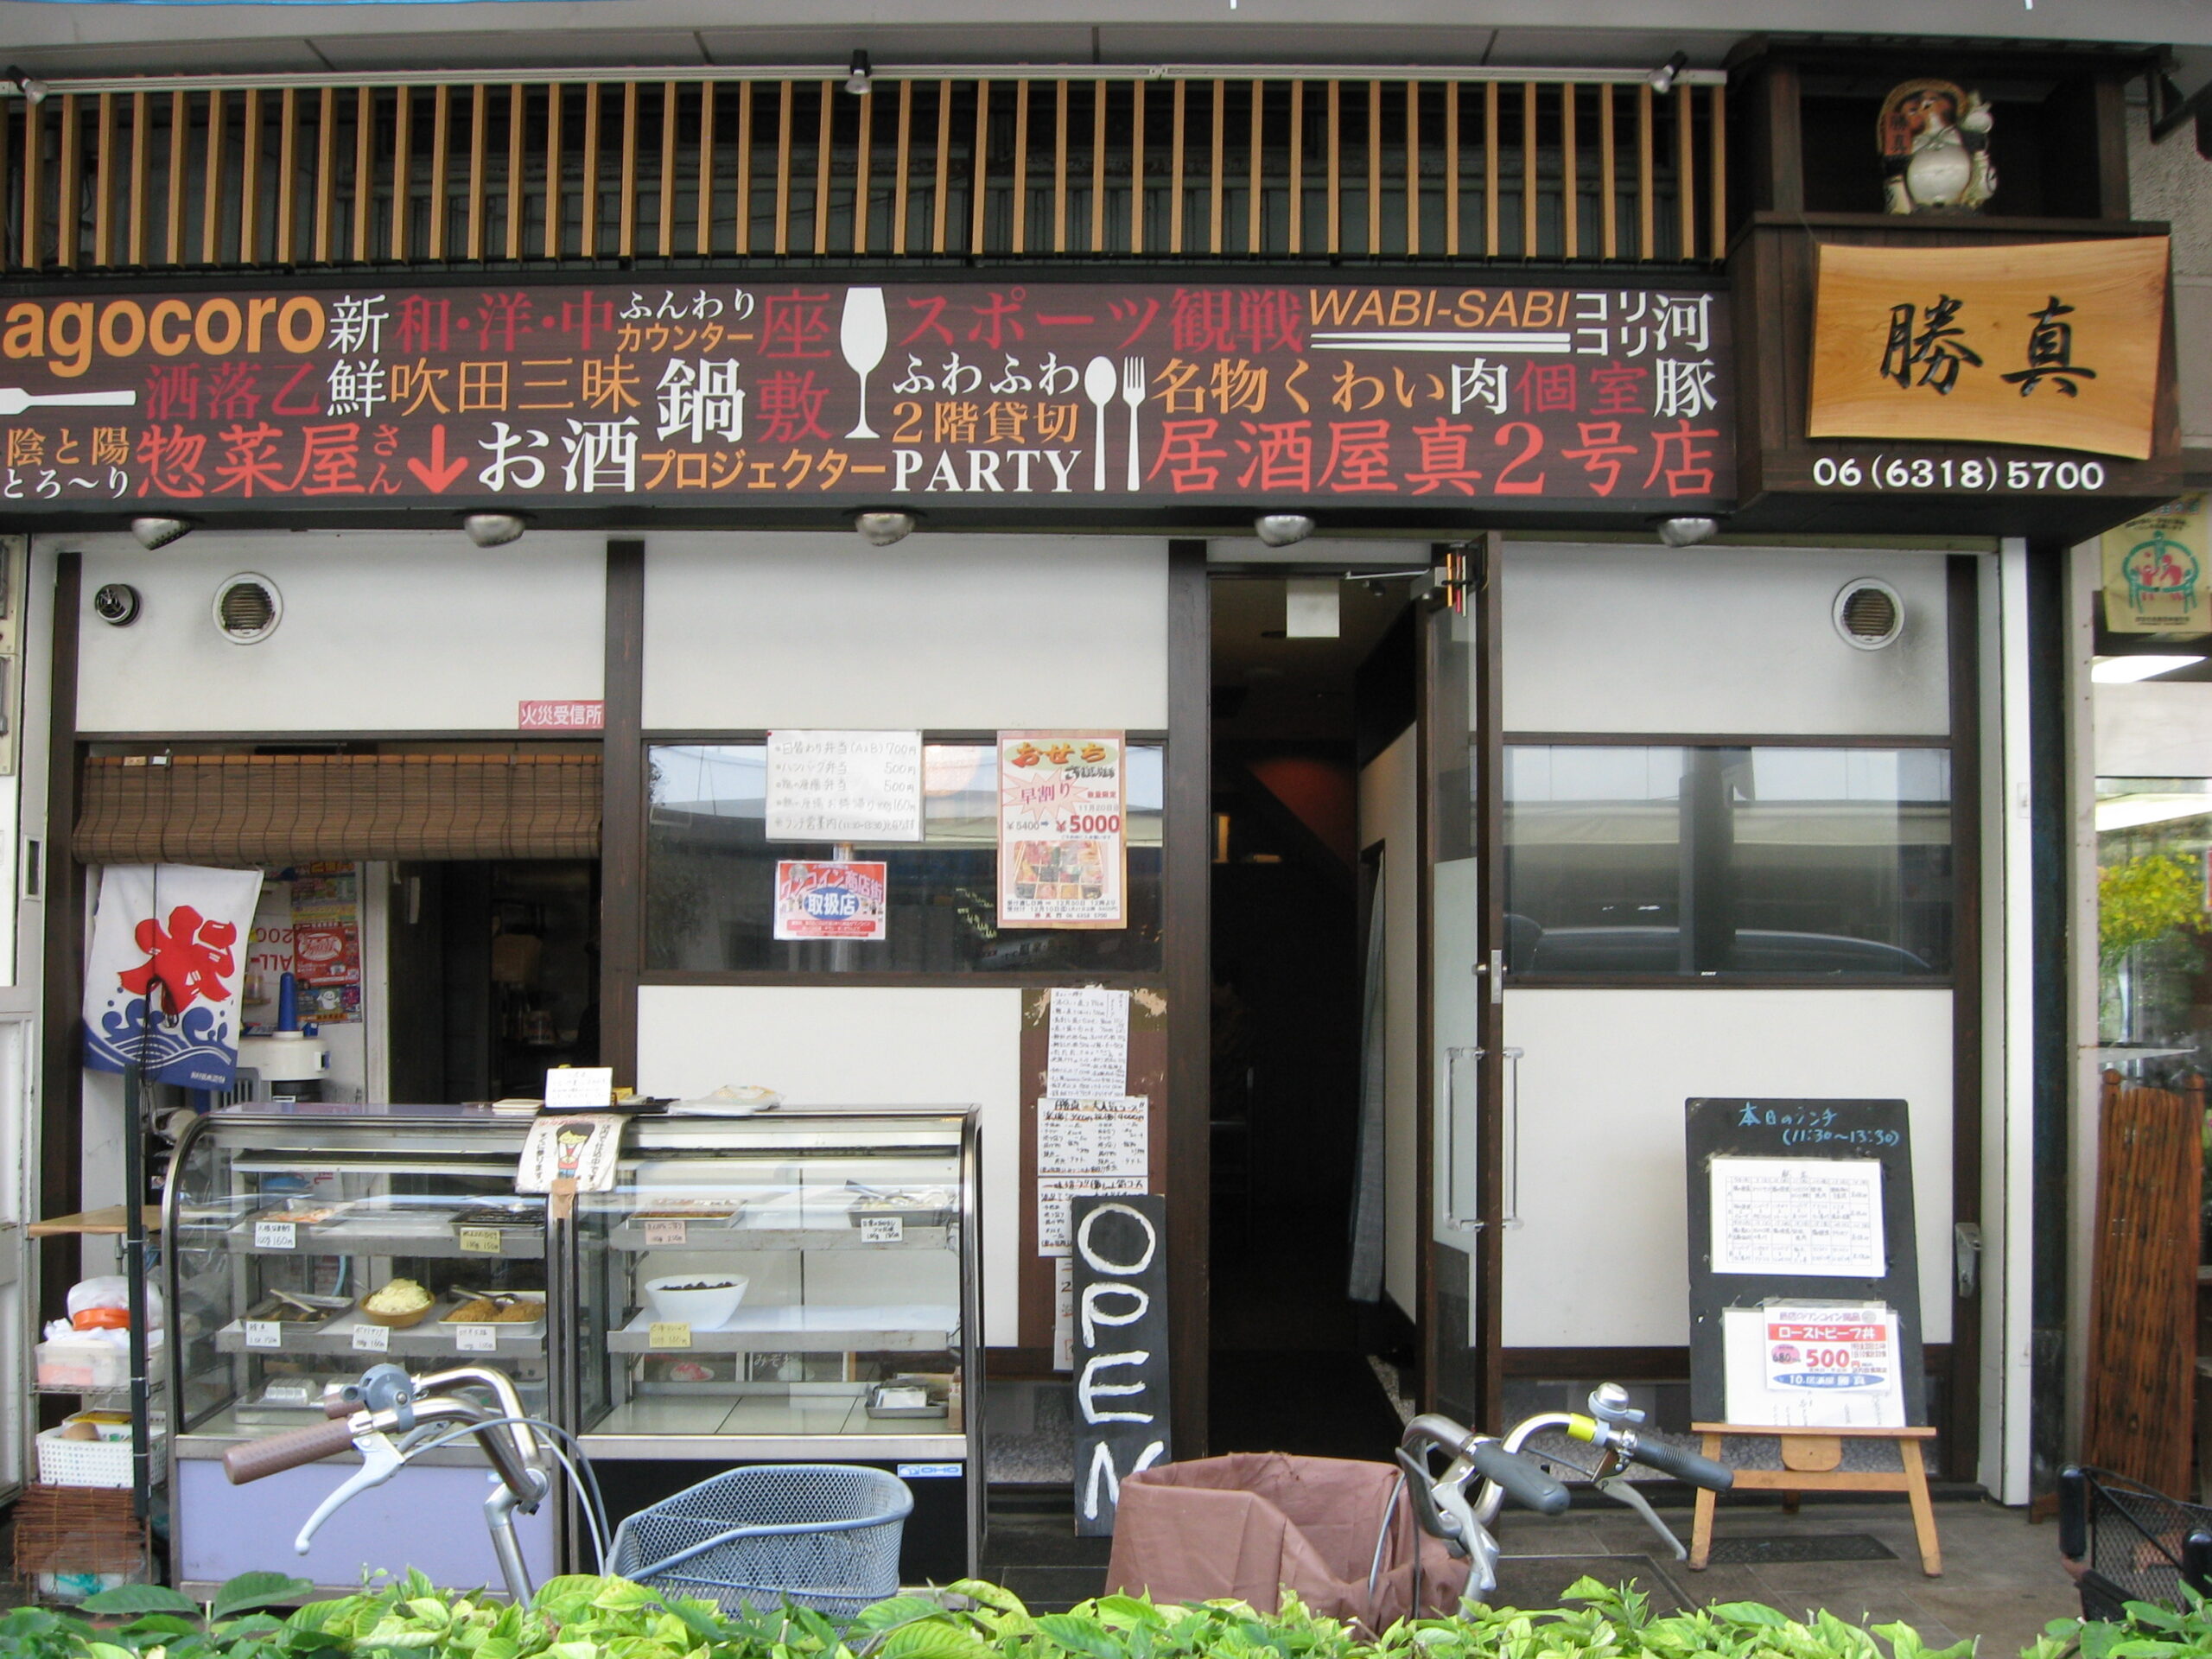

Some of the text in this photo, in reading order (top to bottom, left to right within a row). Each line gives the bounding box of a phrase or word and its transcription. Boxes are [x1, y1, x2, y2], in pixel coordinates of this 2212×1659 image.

[619, 288, 756, 321] ふんわり
[899, 285, 1303, 355] スポーツ観戦
[1309, 289, 1570, 328] WABI-SABI
[3, 296, 327, 378] agocoro
[617, 321, 754, 353] カウンター
[1880, 293, 2097, 397] 勝真
[144, 360, 323, 422] 洒落乙
[391, 353, 641, 416] 吹田三昧
[893, 353, 1080, 397] ふわふわ
[1514, 359, 1649, 416] 個室
[655, 357, 747, 443] 鍋
[893, 400, 1079, 445] 2階貸切
[7, 429, 130, 467] 陰と陽
[477, 416, 641, 493] お酒
[641, 448, 888, 491] プロジェクター
[892, 448, 1082, 493] PARTY
[1147, 416, 1720, 498] 居酒屋真2号店
[521, 704, 602, 725] 火災受信所
[1011, 741, 1107, 767] おせち
[1021, 783, 1071, 804] 早割り
[807, 893, 855, 916] 取扱店
